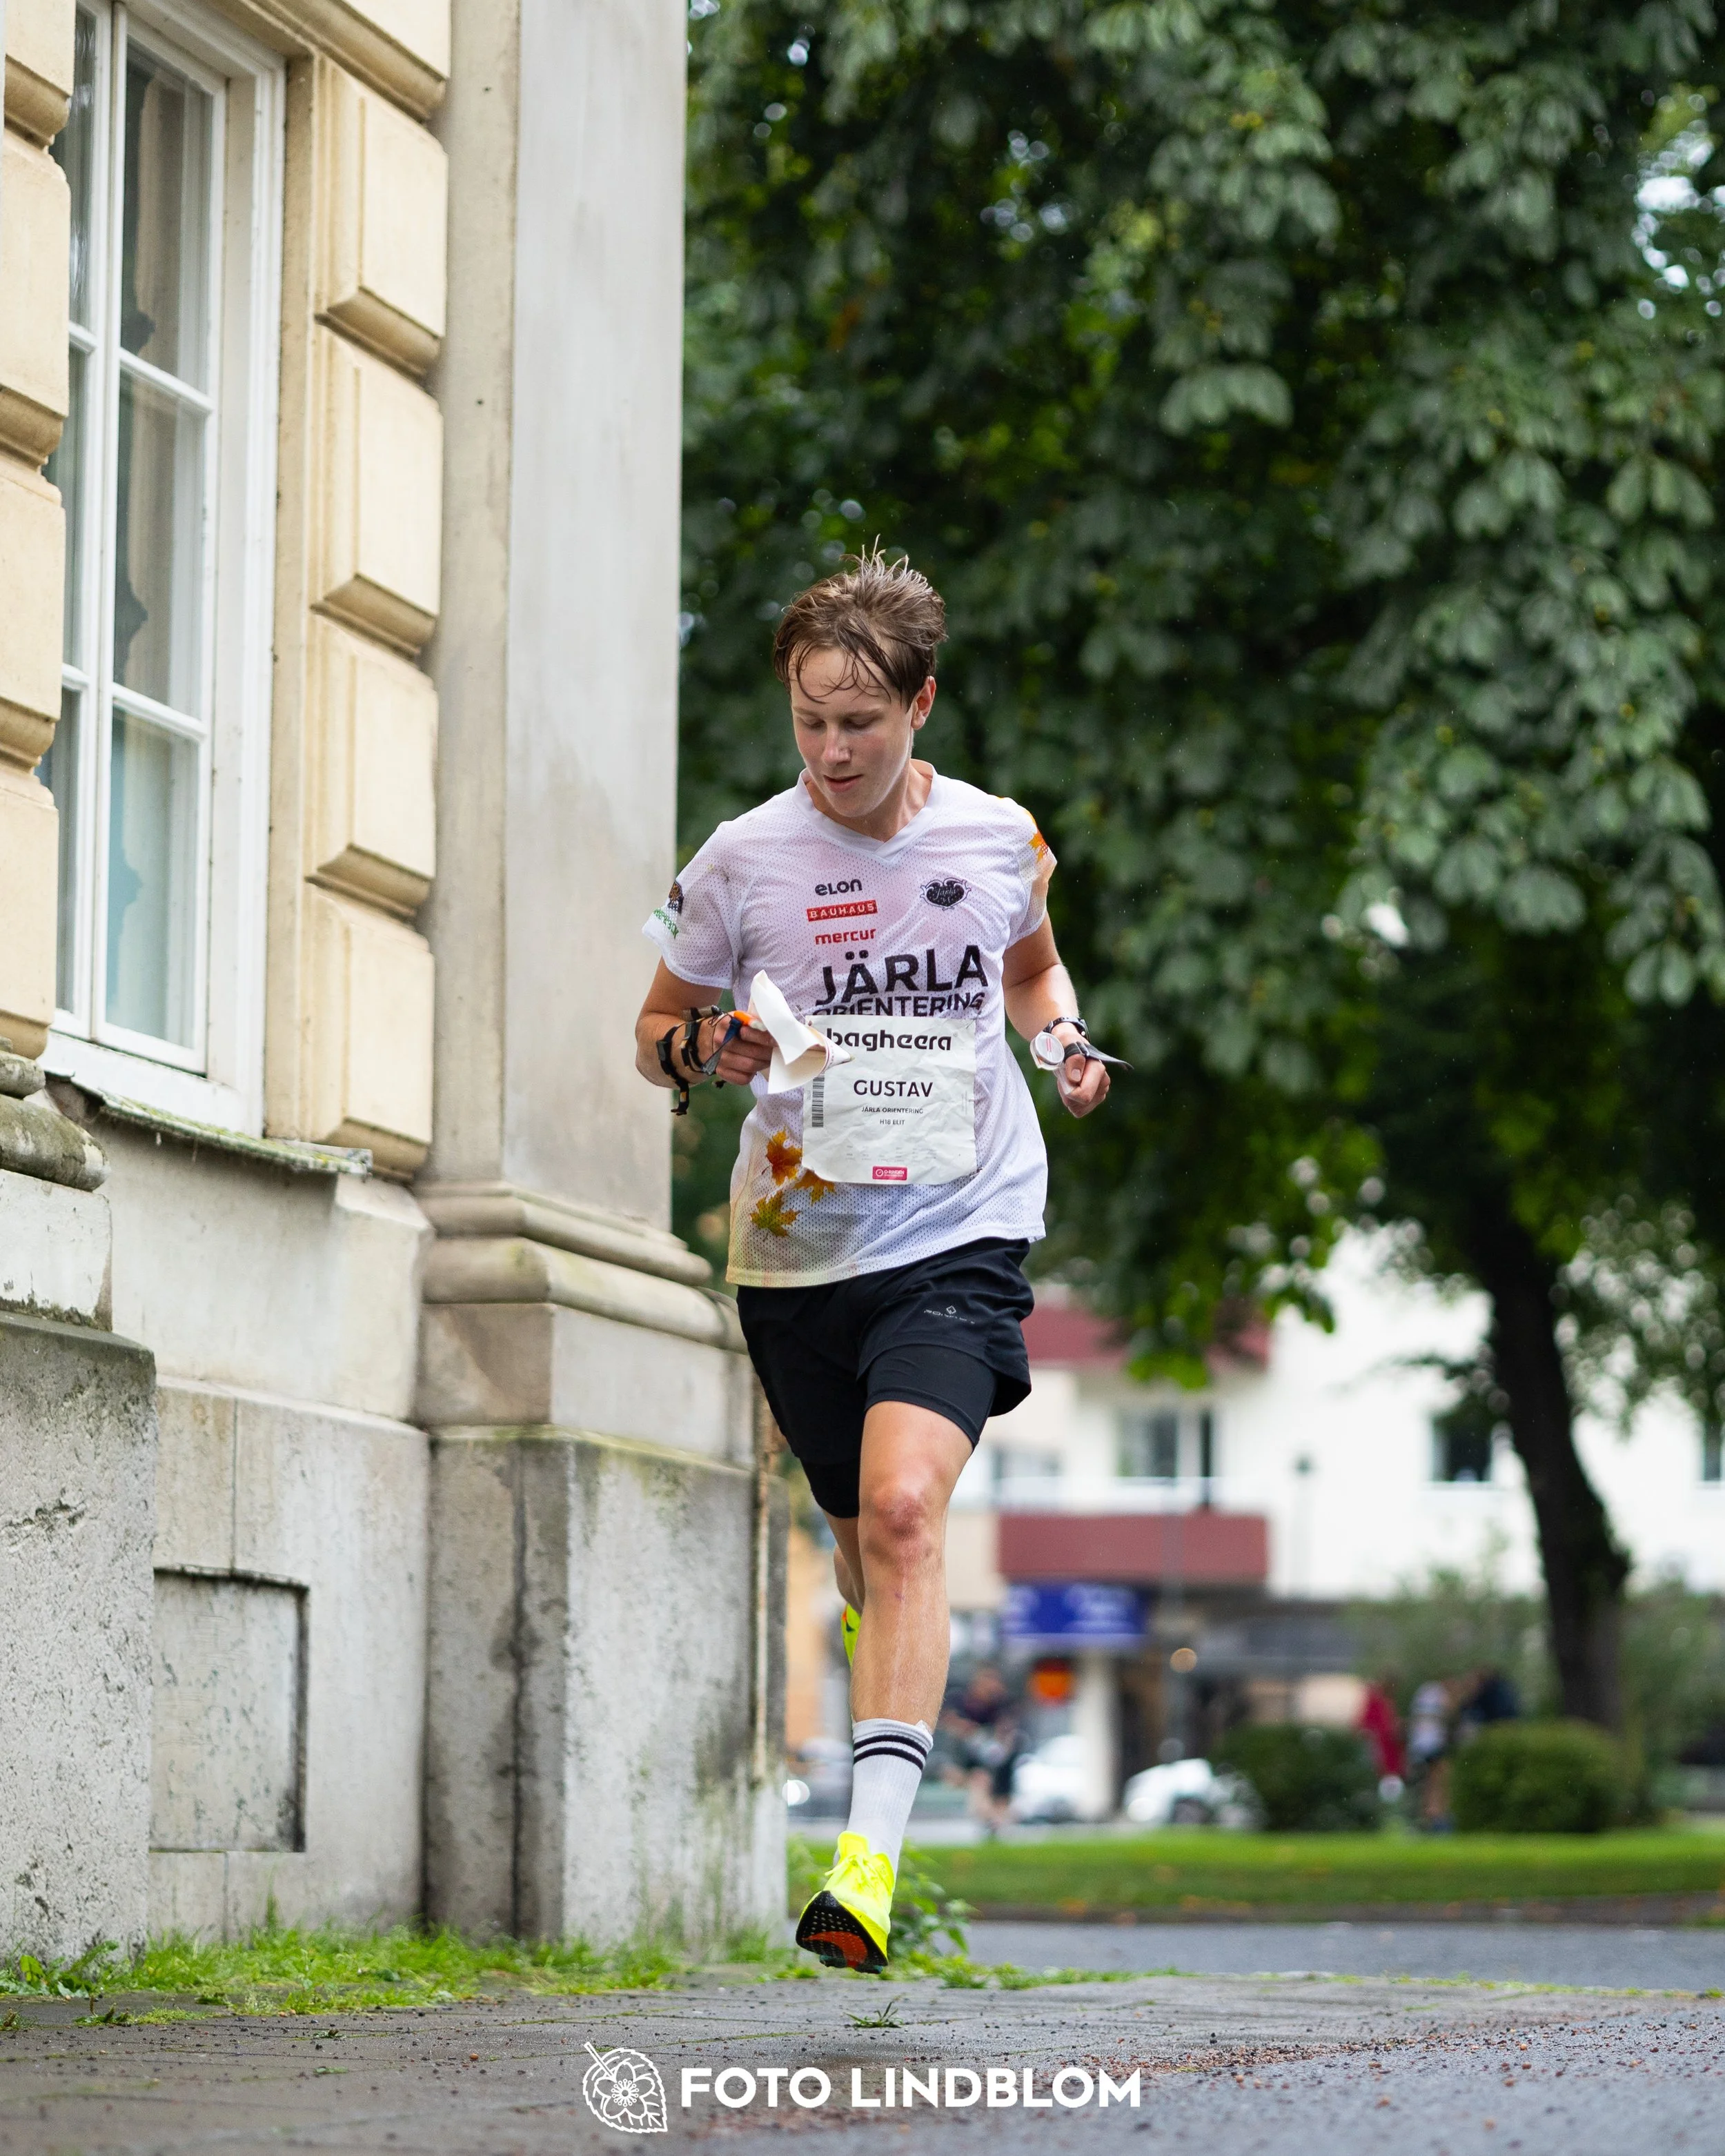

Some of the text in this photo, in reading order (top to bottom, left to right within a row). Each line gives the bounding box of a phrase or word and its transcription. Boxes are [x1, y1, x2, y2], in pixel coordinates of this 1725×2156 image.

[810, 903, 874, 918] BAUHAUS
[815, 929, 876, 945] mercur
[815, 945, 988, 1006] JÄRLA
[827, 1027, 952, 1051] bagheera
[853, 1079, 934, 1097] GUSTAV
